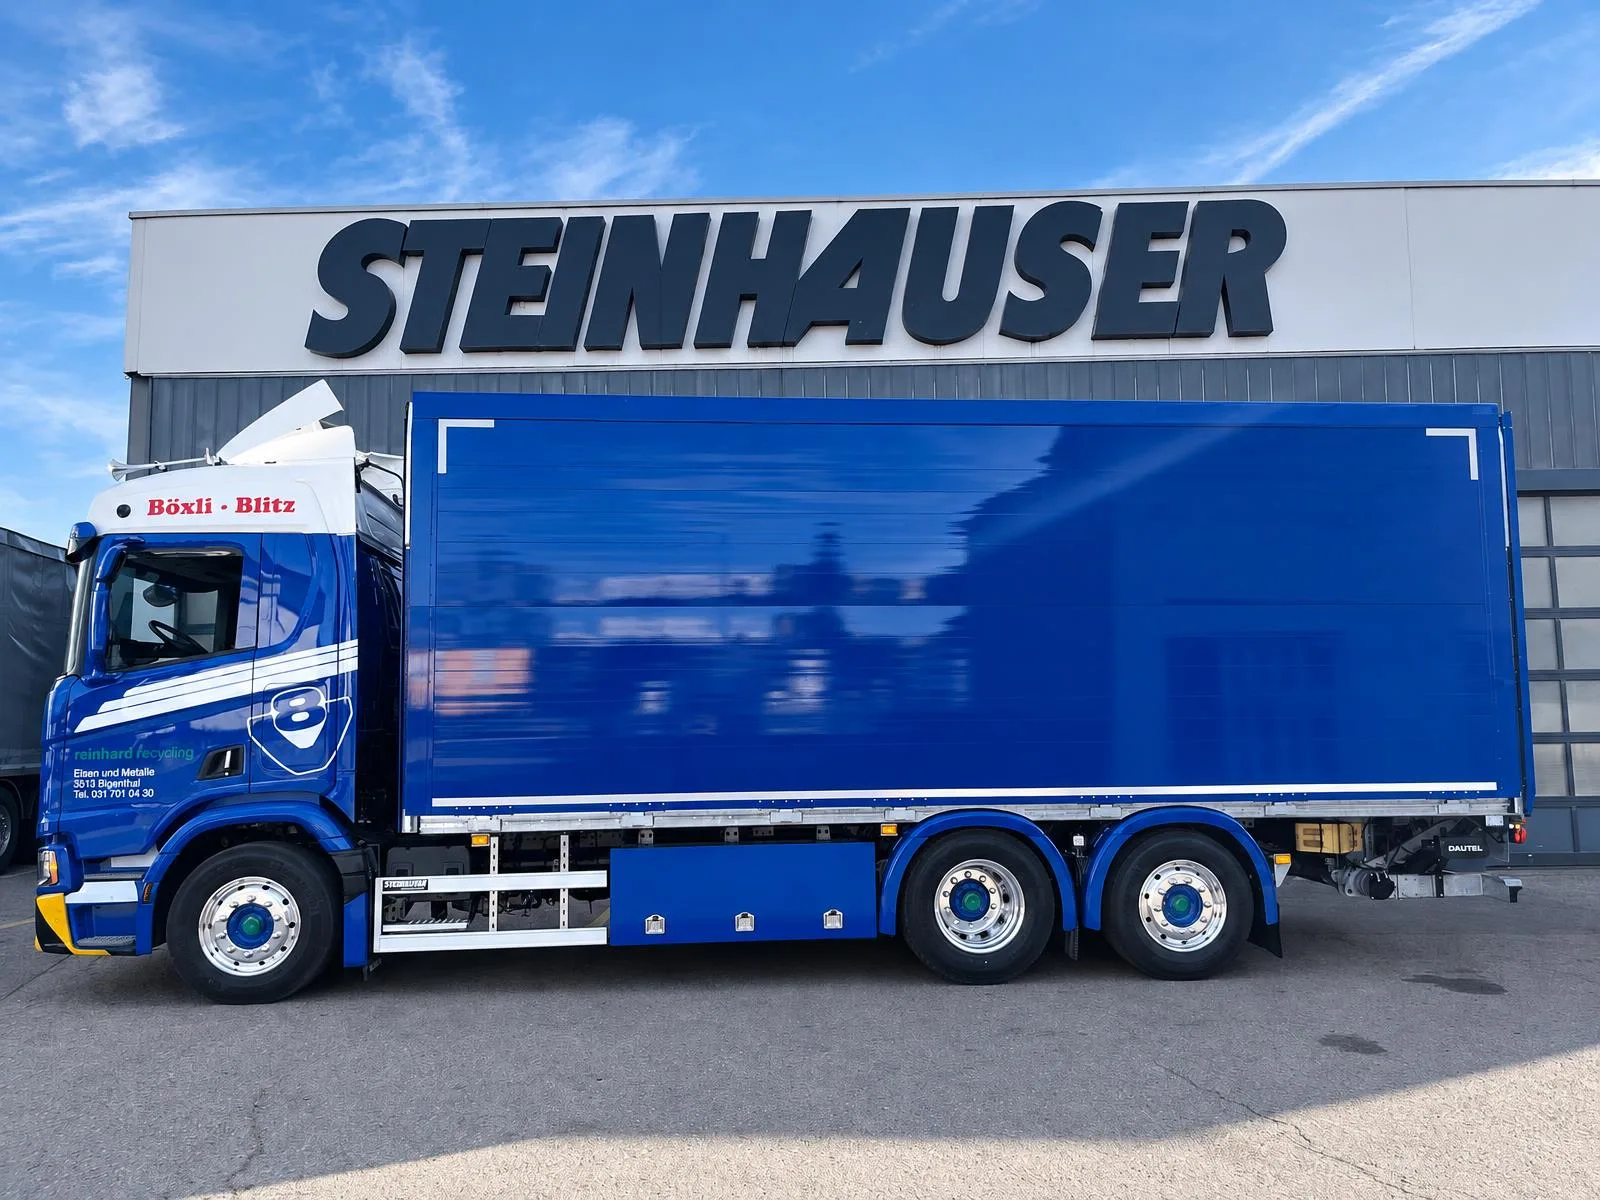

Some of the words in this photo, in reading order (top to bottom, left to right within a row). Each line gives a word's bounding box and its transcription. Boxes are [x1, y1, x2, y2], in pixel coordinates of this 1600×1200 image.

[304, 199, 1287, 359] STEINHAUSER
[147, 498, 212, 516] Böxli
[235, 496, 296, 513] Blitz
[74, 747, 133, 760] reinhard
[137, 746, 194, 762] recycling
[102, 768, 119, 777] und
[121, 767, 155, 777] Metalle
[73, 790, 89, 799] Tel.
[91, 789, 107, 798] 031
[110, 789, 125, 798] 701
[128, 789, 140, 798] 04
[142, 788, 154, 798] 30
